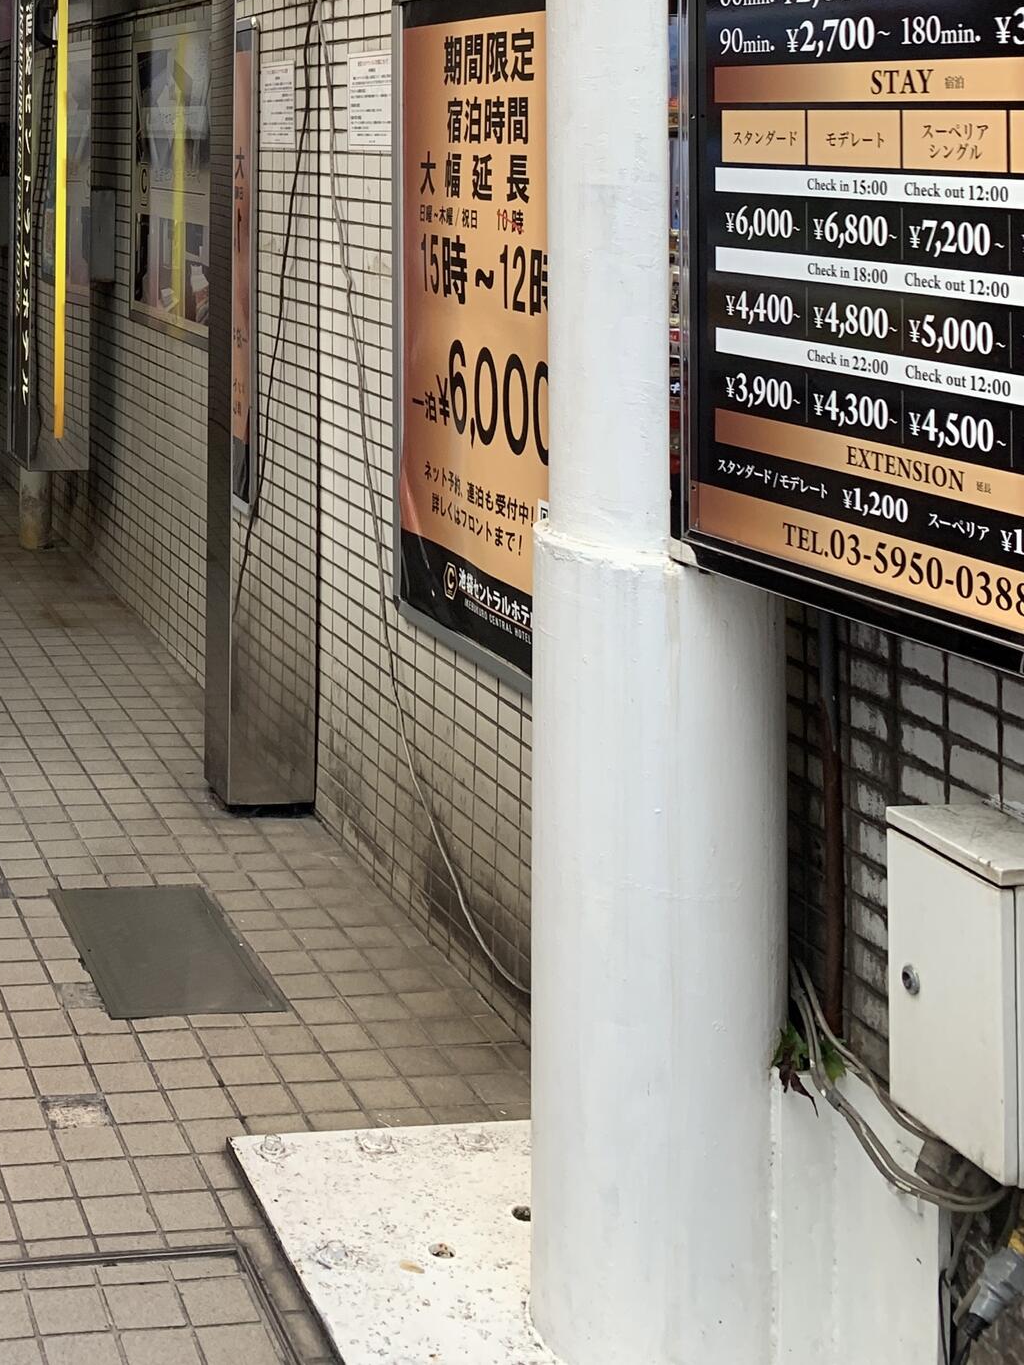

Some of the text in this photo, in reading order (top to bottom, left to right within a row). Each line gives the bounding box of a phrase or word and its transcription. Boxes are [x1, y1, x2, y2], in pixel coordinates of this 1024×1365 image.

[719, 28, 775, 55] 90min.
[900, 15, 981, 46] 180min.
[444, 28, 535, 85] 期間限定
[870, 69, 934, 96] STAY
[447, 96, 529, 145] 宿泊時間
[921, 122, 990, 140] スーペリア
[733, 129, 798, 147] スタンダード
[825, 130, 886, 149] モデレート
[928, 144, 984, 161] シングル
[420, 150, 530, 204] 大幅延長
[807, 177, 888, 196] Check in 15:00
[904, 182, 1009, 202] Check out 12:00
[807, 262, 888, 285] Check in 18:00
[904, 271, 1010, 299] Check out 12:00
[807, 348, 889, 376] Check in 22:00
[904, 364, 1011, 397] Check out 12:00
[846, 445, 965, 493] EXTENSION
[842, 486, 909, 523] ¥1,200
[928, 512, 990, 541] スーペリア
